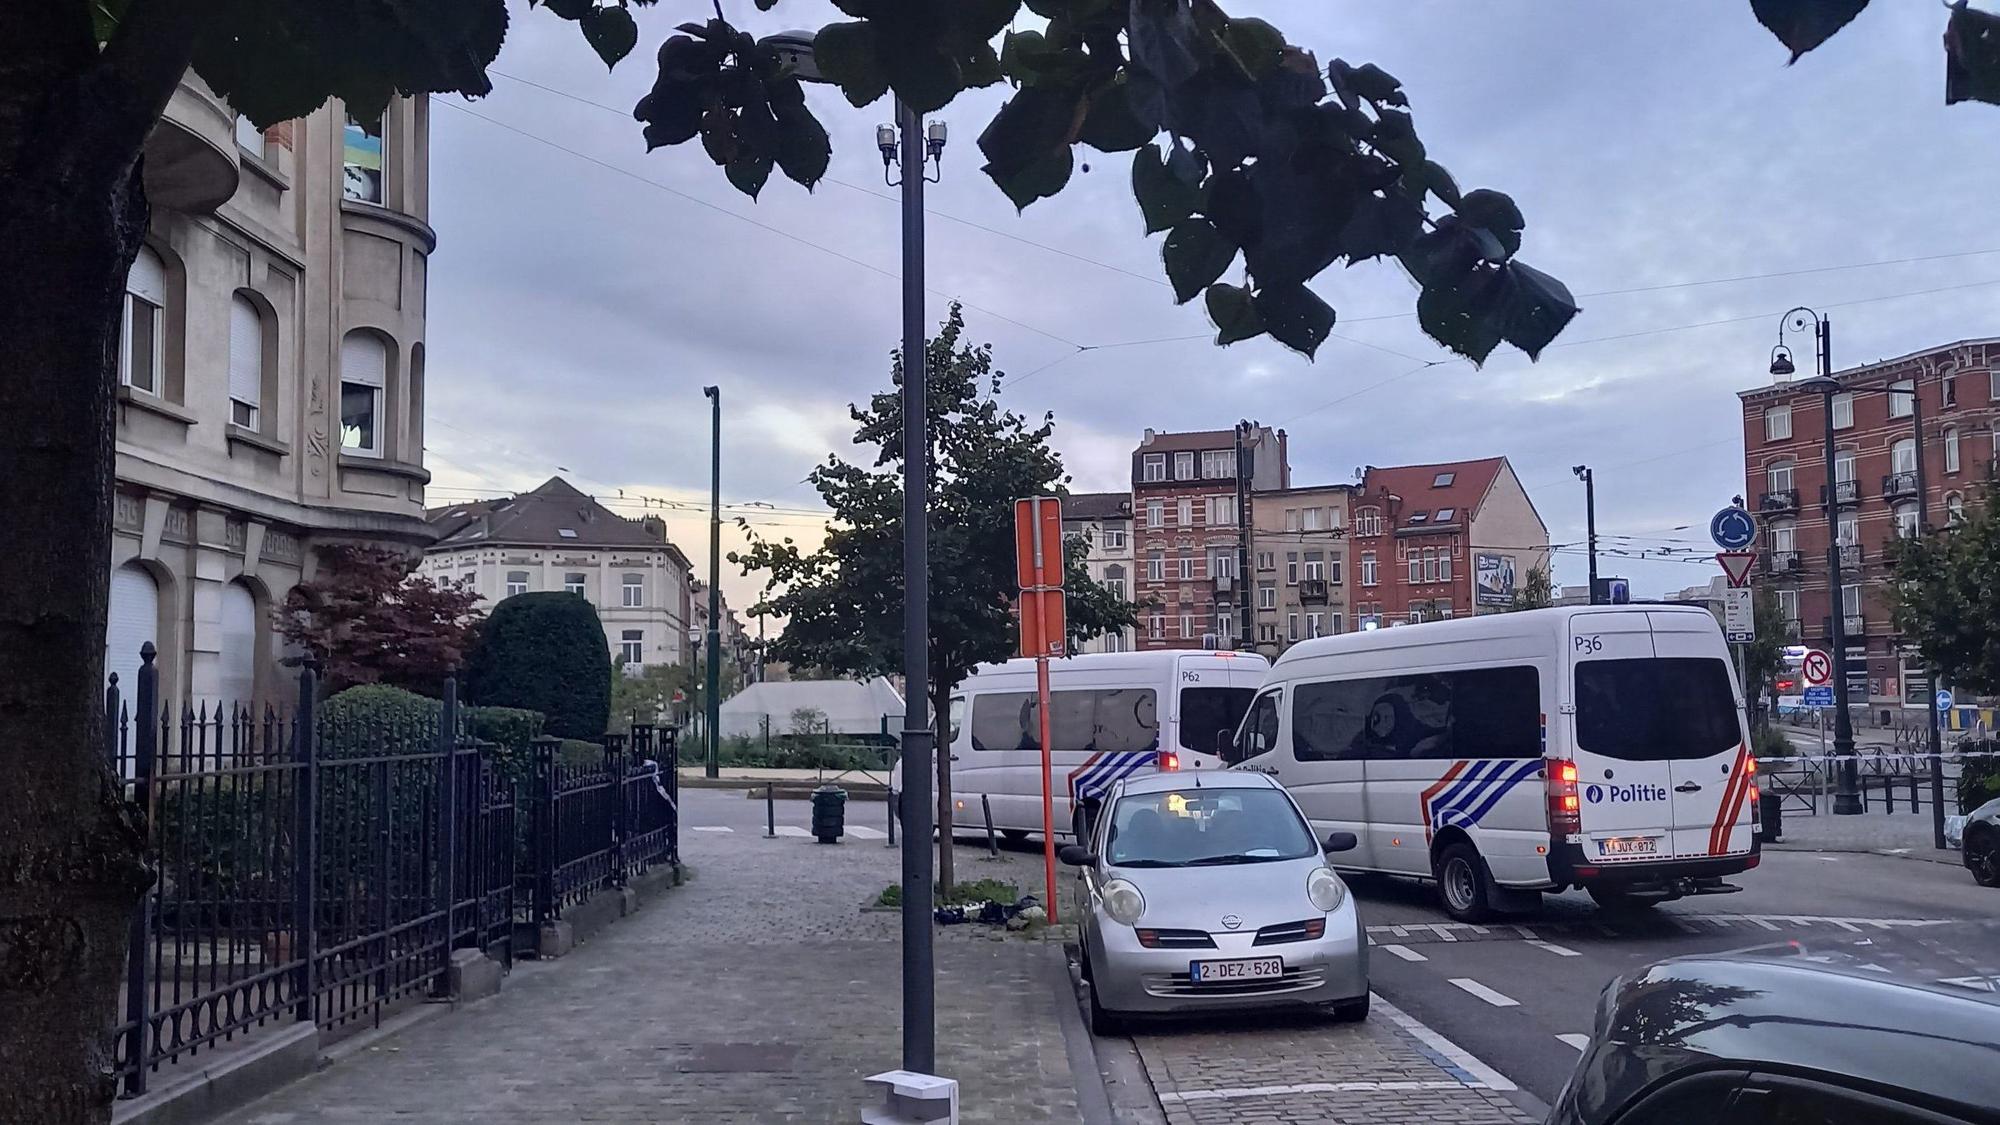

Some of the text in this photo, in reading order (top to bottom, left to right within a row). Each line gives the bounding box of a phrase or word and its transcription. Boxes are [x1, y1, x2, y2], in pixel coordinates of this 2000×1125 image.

[1575, 635, 1602, 654] P36
[1182, 671, 1200, 681] P62
[1609, 783, 1666, 803] Politie
